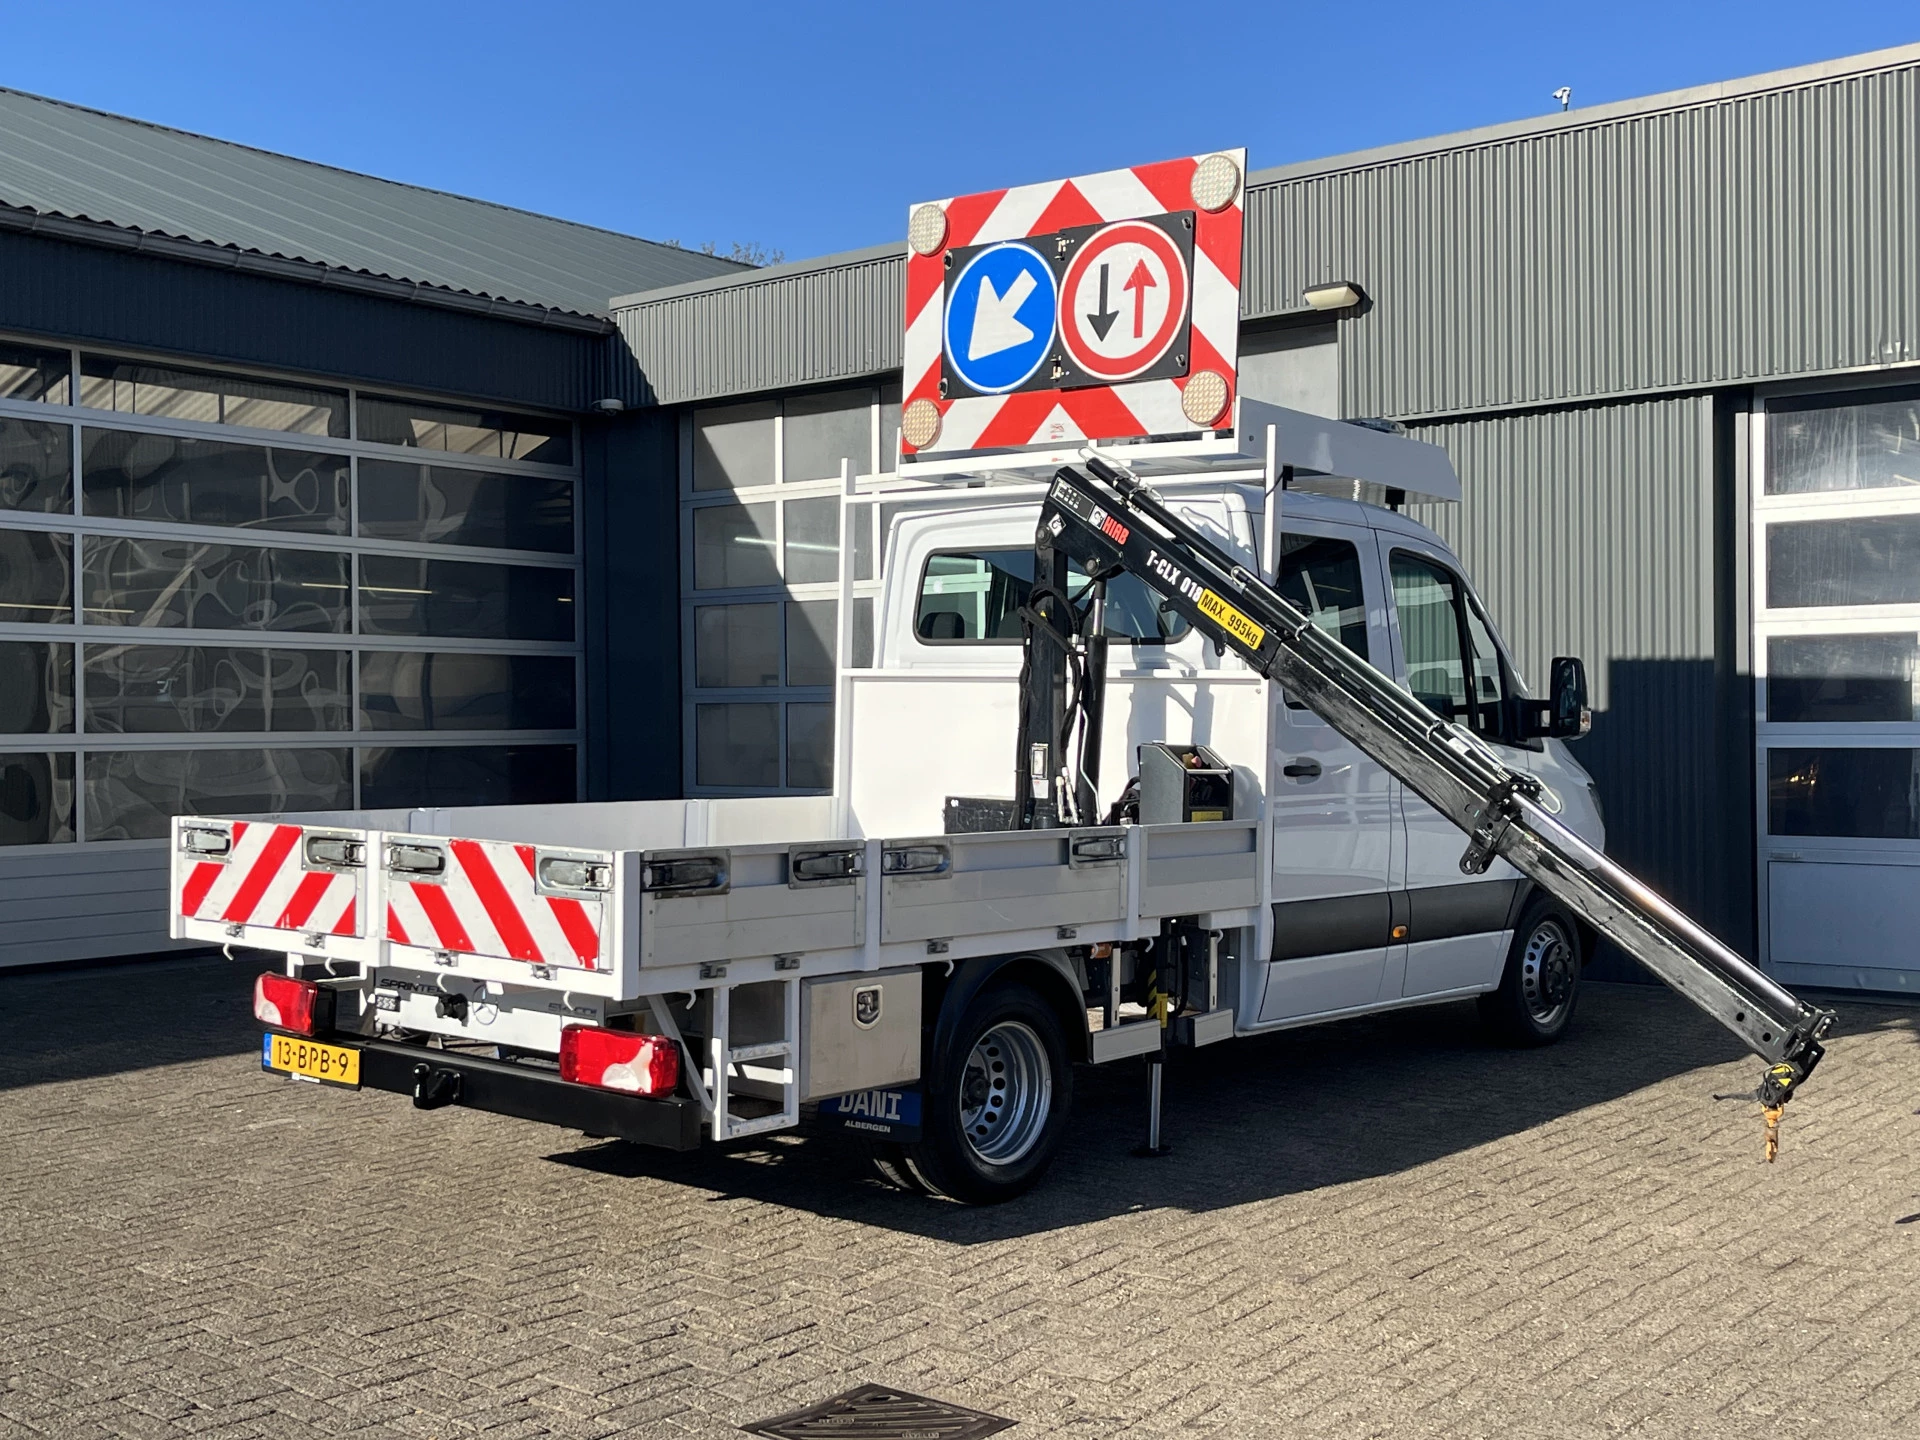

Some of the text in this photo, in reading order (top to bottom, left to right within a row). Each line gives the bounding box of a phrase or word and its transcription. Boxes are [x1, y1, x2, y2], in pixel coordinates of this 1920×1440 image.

[1102, 515, 1130, 545] HIAB
[1146, 550, 1204, 602] T-CLX 018
[1201, 593, 1259, 647] MAX. 995kg
[275, 1040, 349, 1077] 13-BPB-9
[838, 1090, 902, 1121] DANI
[844, 1120, 891, 1133] ALBERGEN
